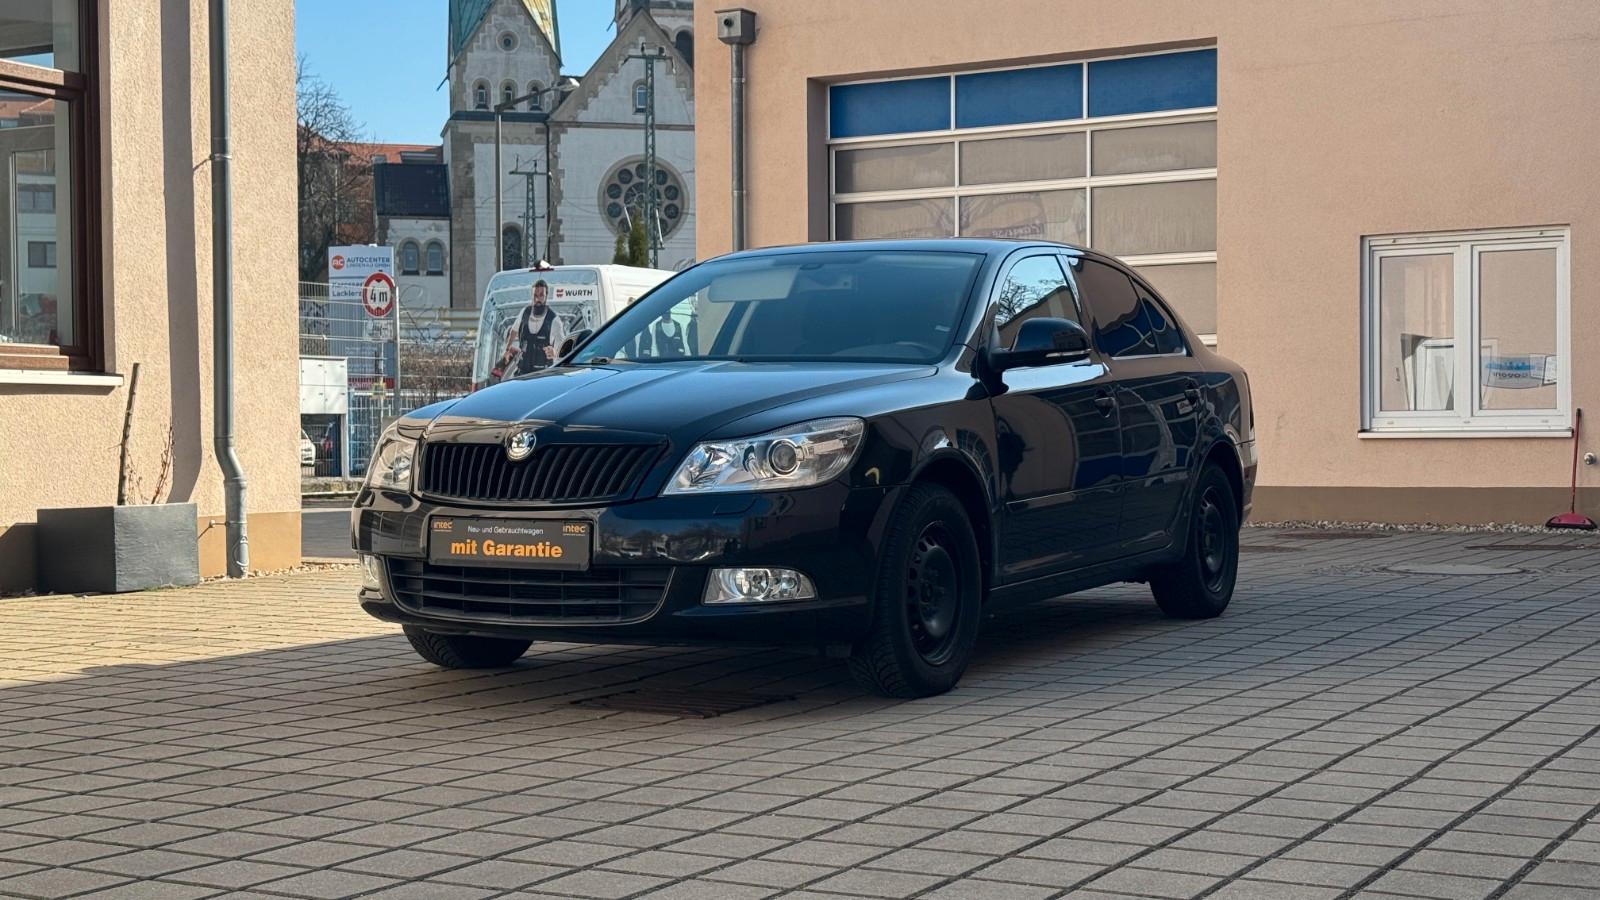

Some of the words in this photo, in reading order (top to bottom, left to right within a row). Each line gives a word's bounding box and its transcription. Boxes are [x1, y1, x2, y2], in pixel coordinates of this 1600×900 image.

[370, 289, 377, 303] 4
[379, 291, 388, 302] m
[433, 521, 453, 529] intec
[562, 525, 586, 533] intec
[482, 526, 493, 534] und
[494, 526, 544, 536] Gebrauchtwagen
[451, 538, 478, 555] mit
[482, 539, 563, 558] Garantie
